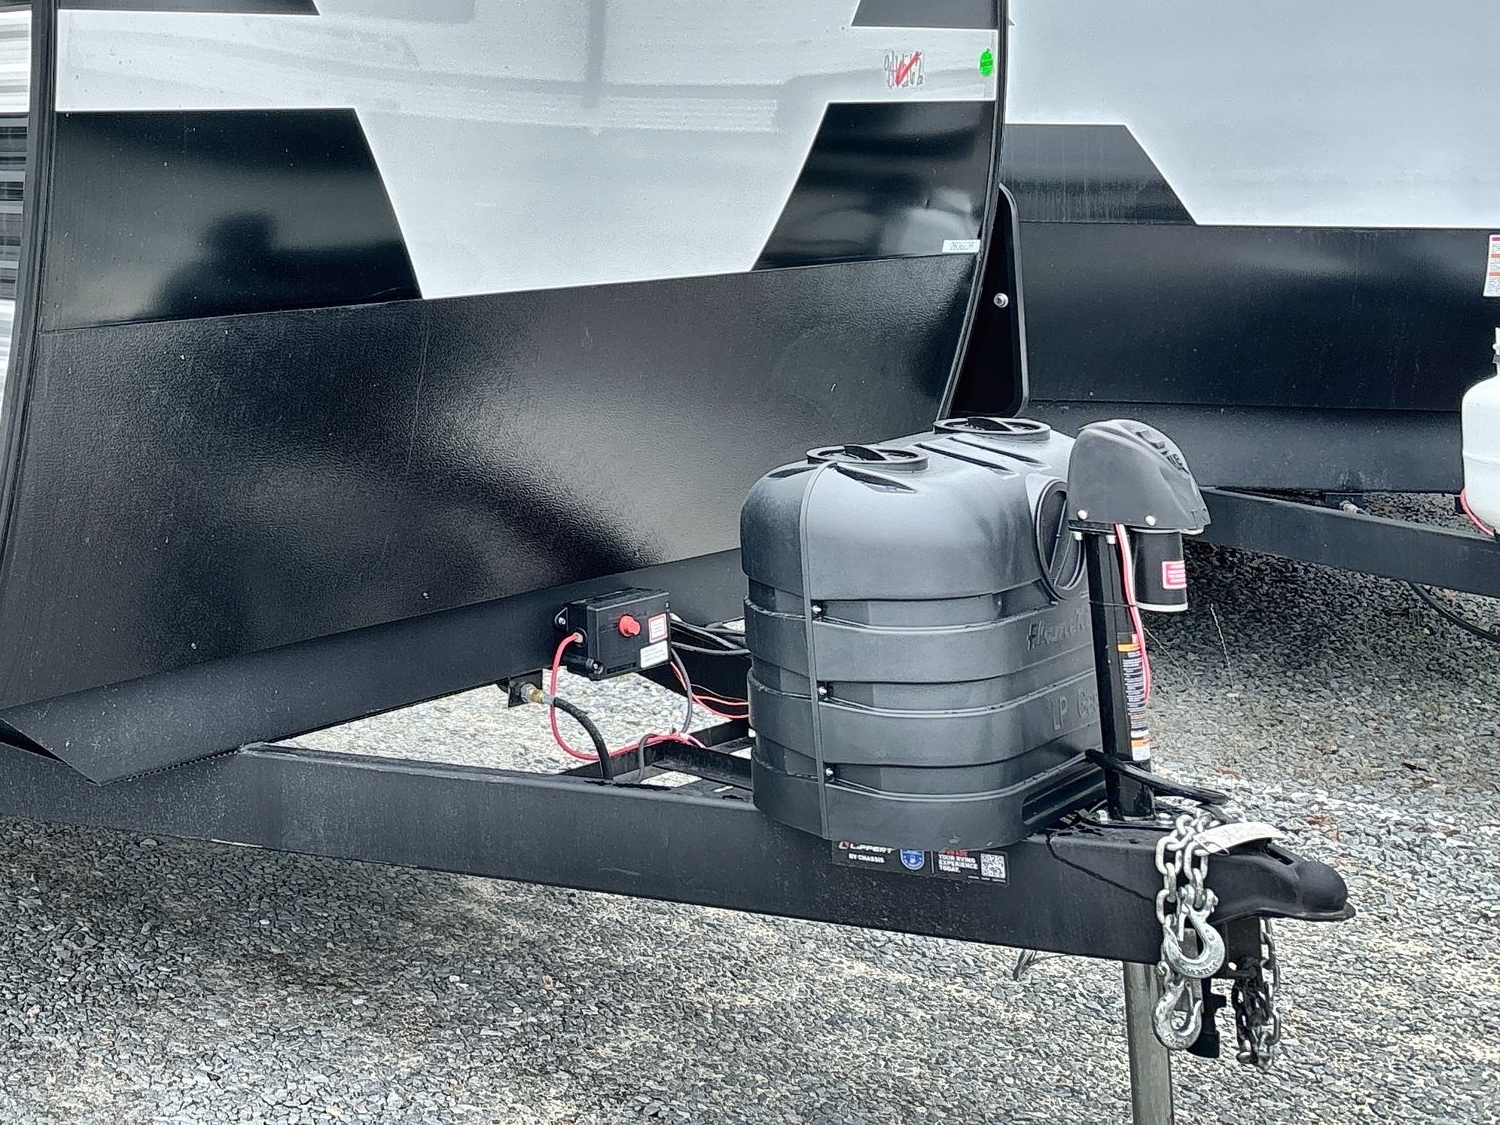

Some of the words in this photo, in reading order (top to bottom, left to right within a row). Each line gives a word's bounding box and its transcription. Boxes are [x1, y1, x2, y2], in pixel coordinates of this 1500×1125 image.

[850, 843, 894, 854] LIPPERT
[858, 854, 885, 864] CHASSIS
[938, 859, 979, 870] EXPERIENCE
